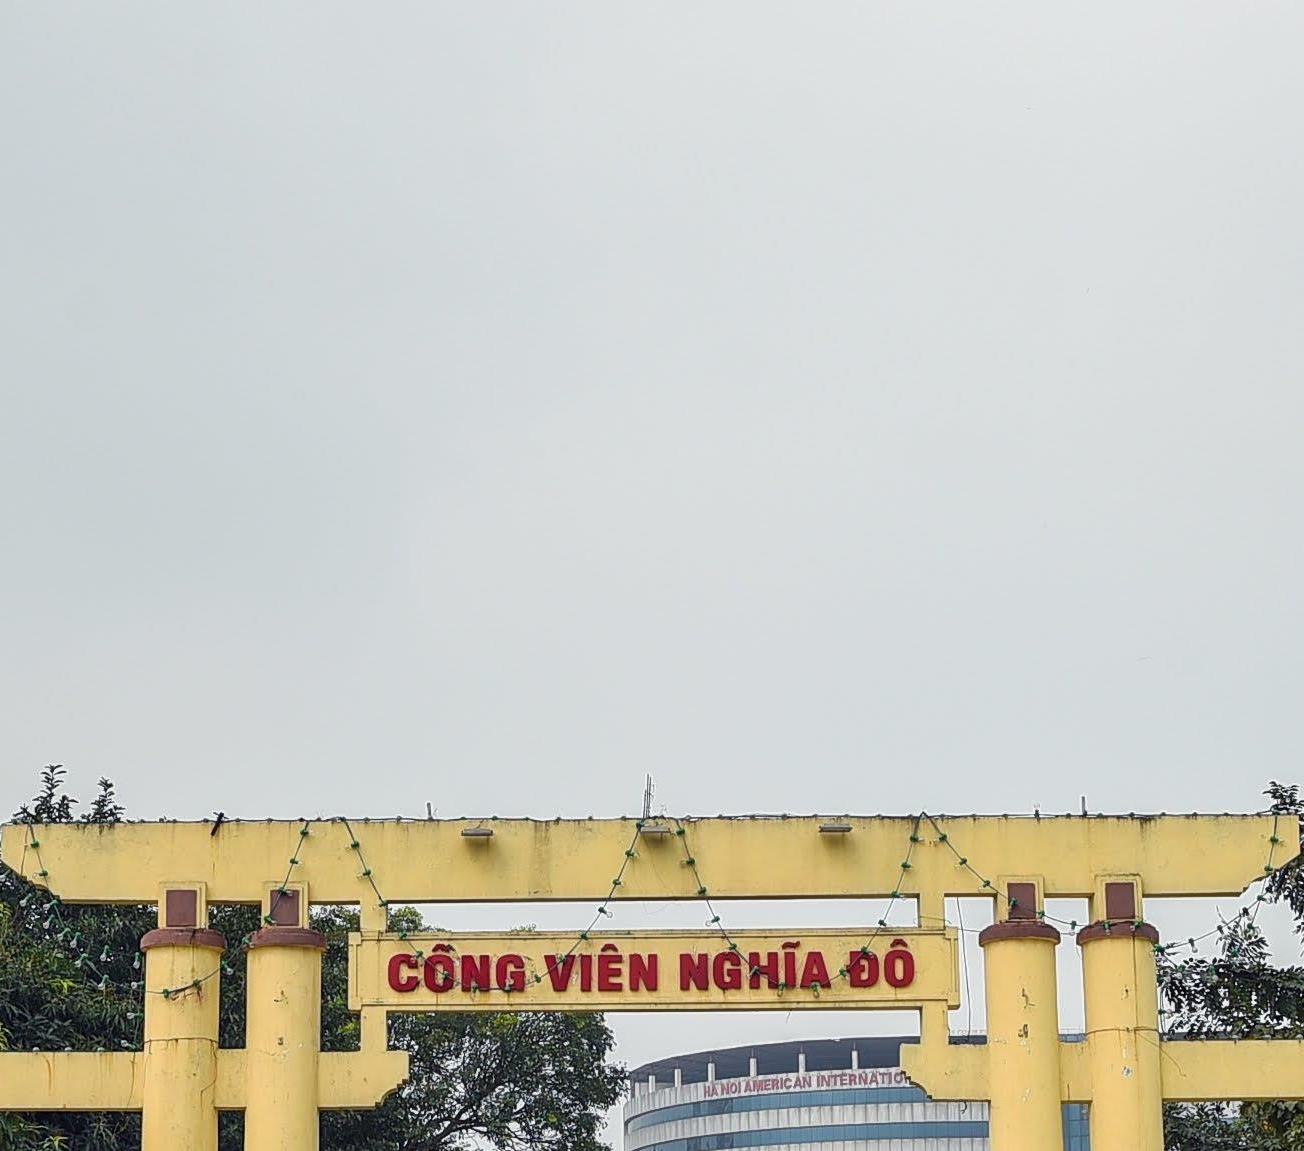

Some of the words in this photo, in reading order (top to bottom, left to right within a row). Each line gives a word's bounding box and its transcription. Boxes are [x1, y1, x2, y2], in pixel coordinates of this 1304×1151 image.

[387, 943, 526, 993] CÔNG
[543, 943, 659, 992] VIÊN
[679, 941, 832, 991] NGHĨA
[849, 939, 916, 988] ĐÔ
[744, 1075, 812, 1093] AMERICAN
